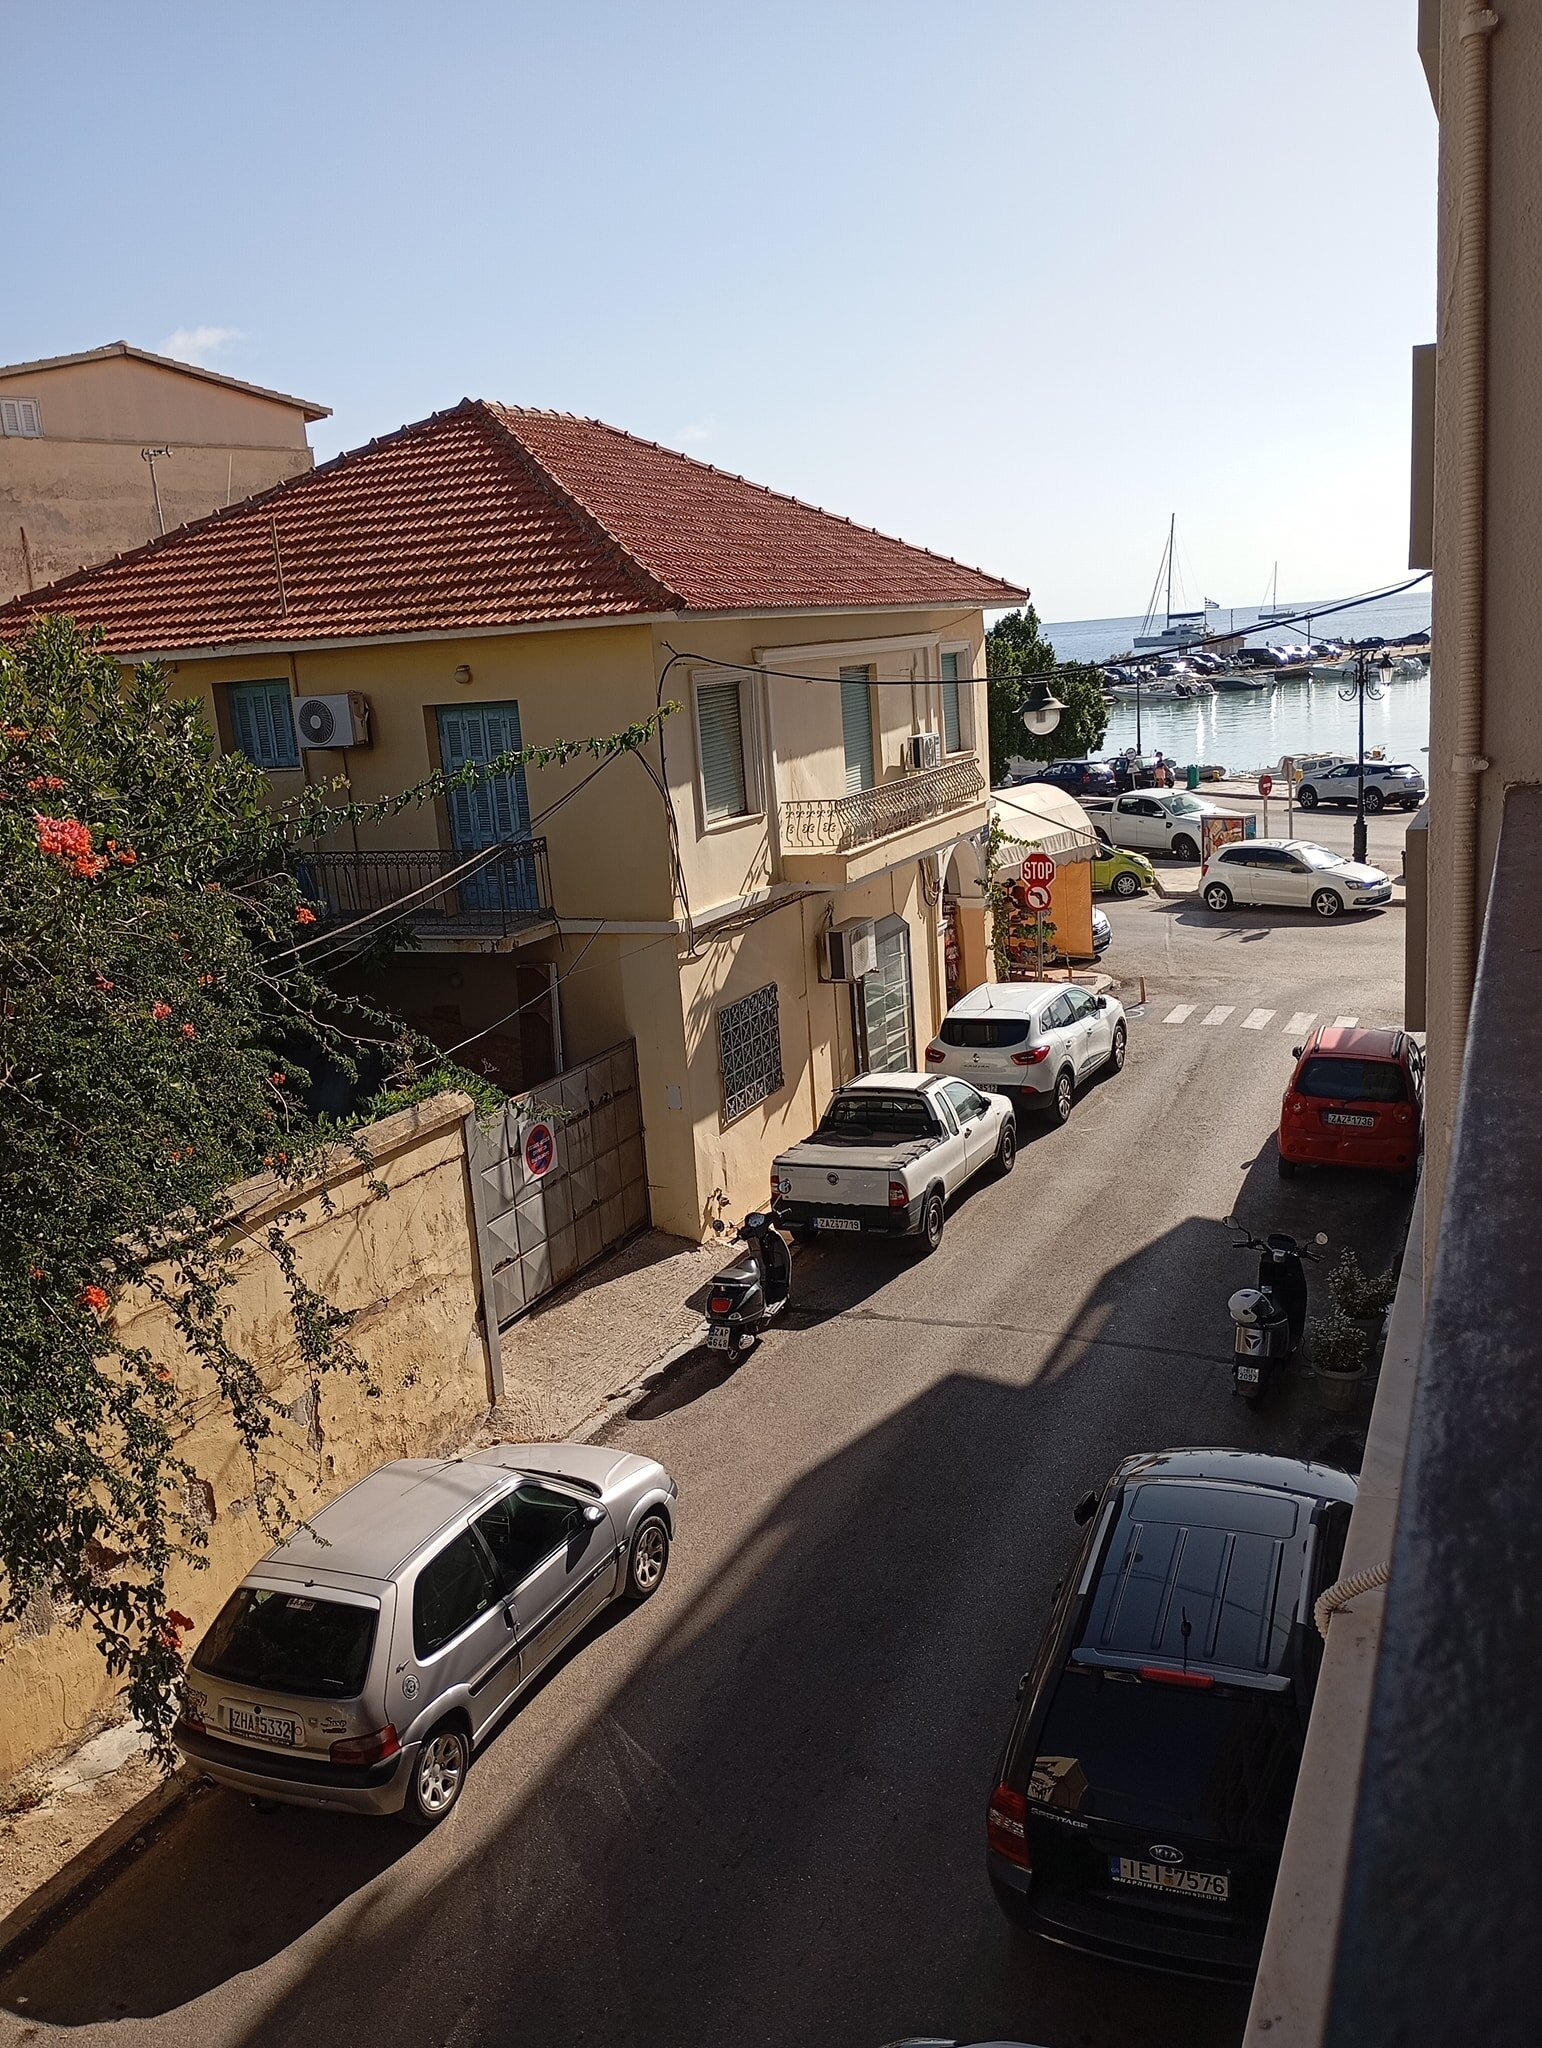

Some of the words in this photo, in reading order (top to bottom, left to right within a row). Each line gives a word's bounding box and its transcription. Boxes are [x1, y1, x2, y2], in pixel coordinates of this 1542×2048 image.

[1024, 861, 1053, 881] STOP
[1031, 1807, 1088, 1829] SPORTAGE
[1155, 1847, 1178, 1860] KIA
